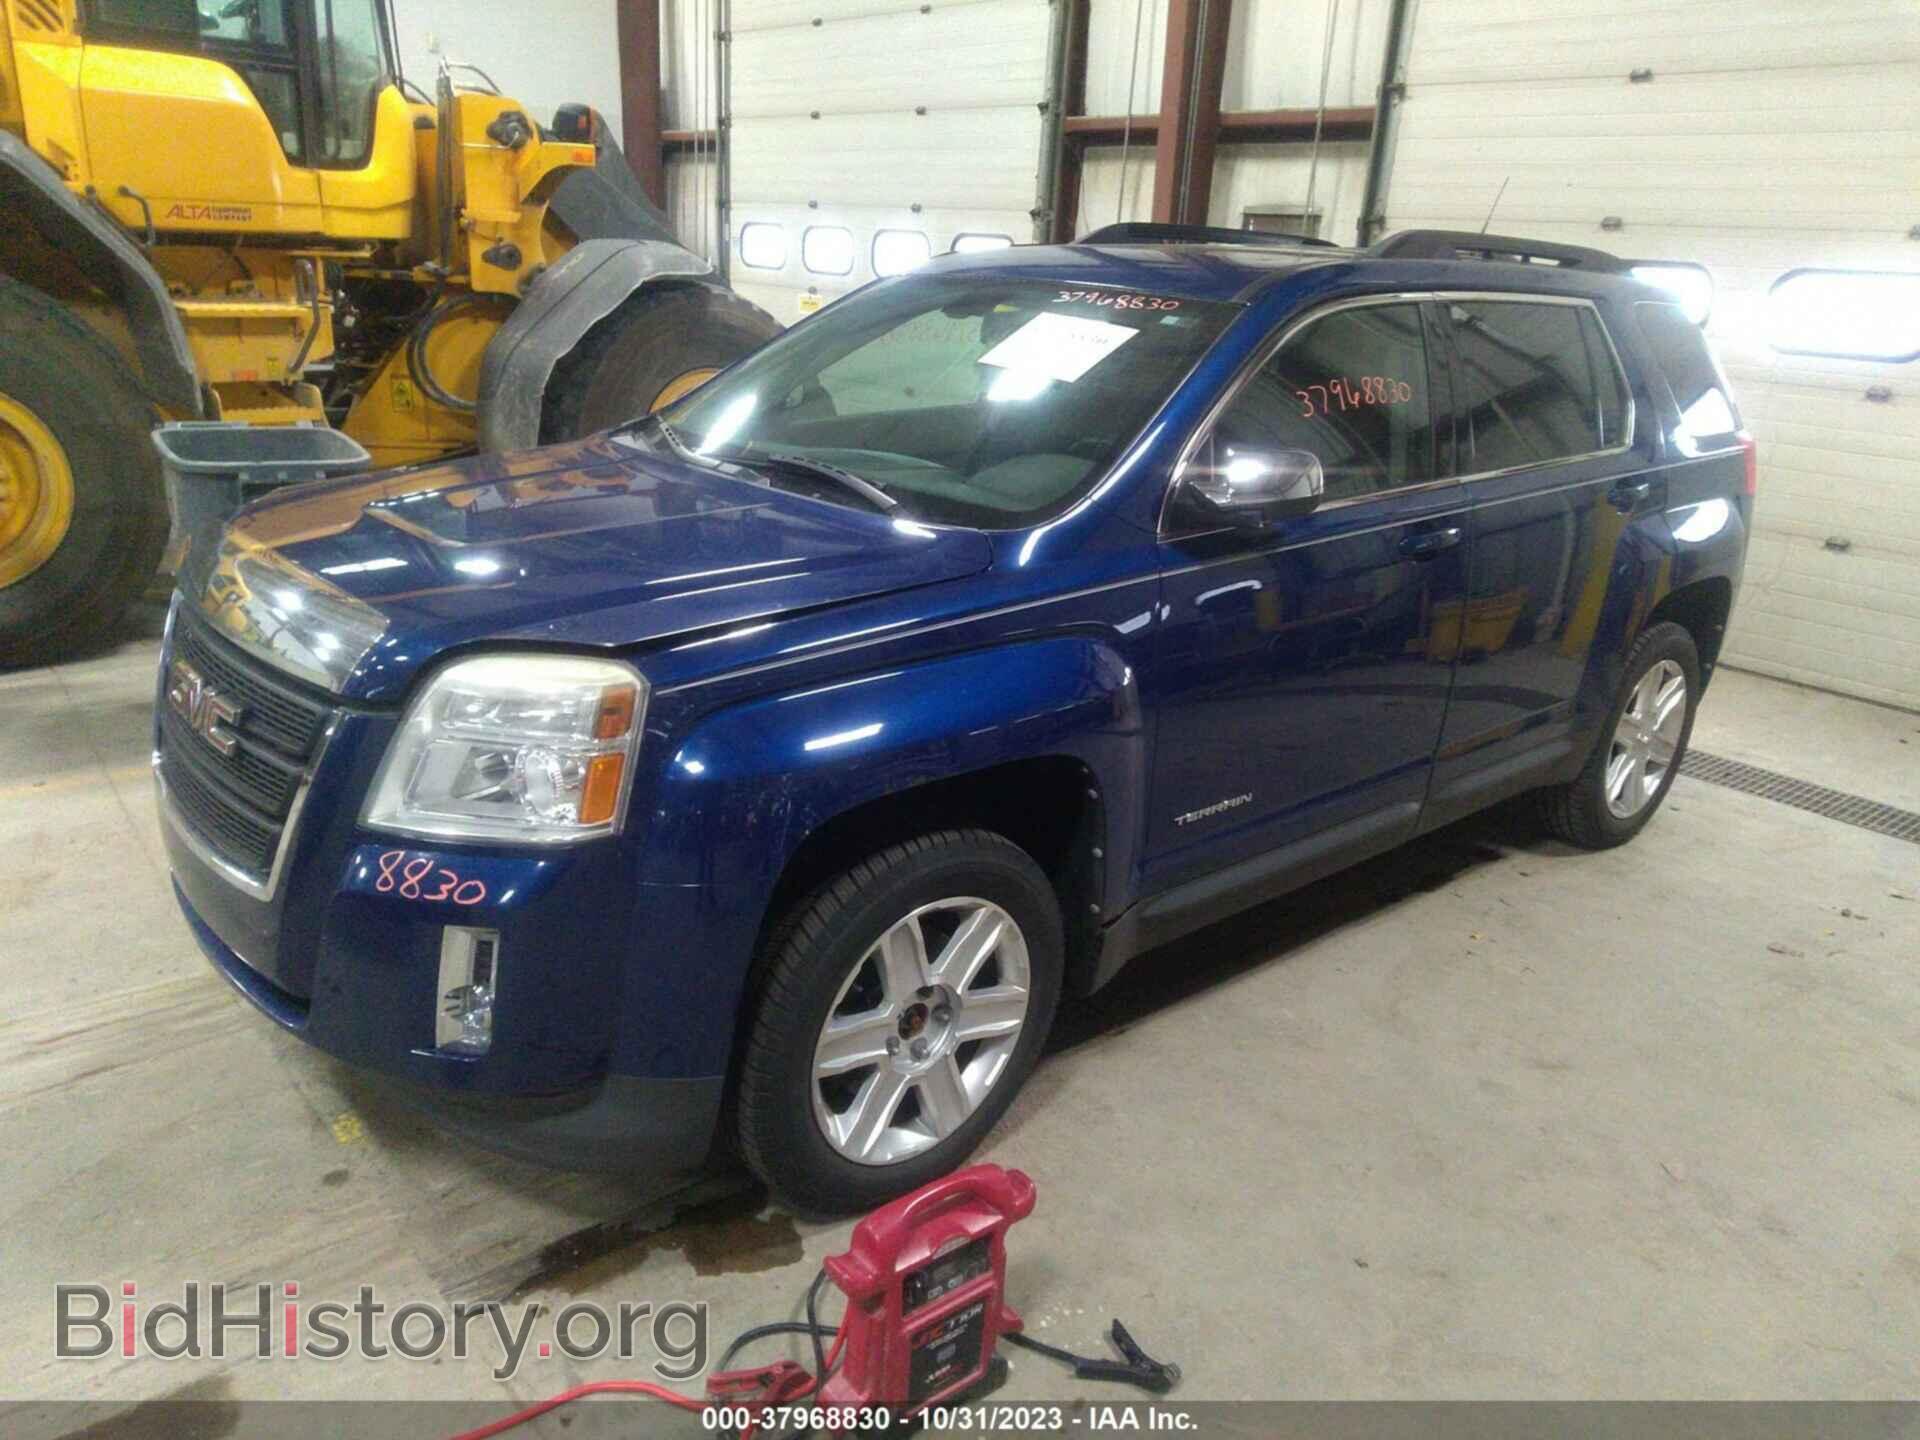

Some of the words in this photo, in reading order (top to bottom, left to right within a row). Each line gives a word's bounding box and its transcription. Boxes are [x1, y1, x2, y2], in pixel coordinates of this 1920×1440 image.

[166, 203, 210, 220] ALTA
[1052, 290, 1180, 311] 37968830
[1295, 376, 1411, 417] 37968830
[168, 661, 241, 756] GMC
[1173, 792, 1253, 826] TERRAIN
[375, 850, 487, 905] 8830
